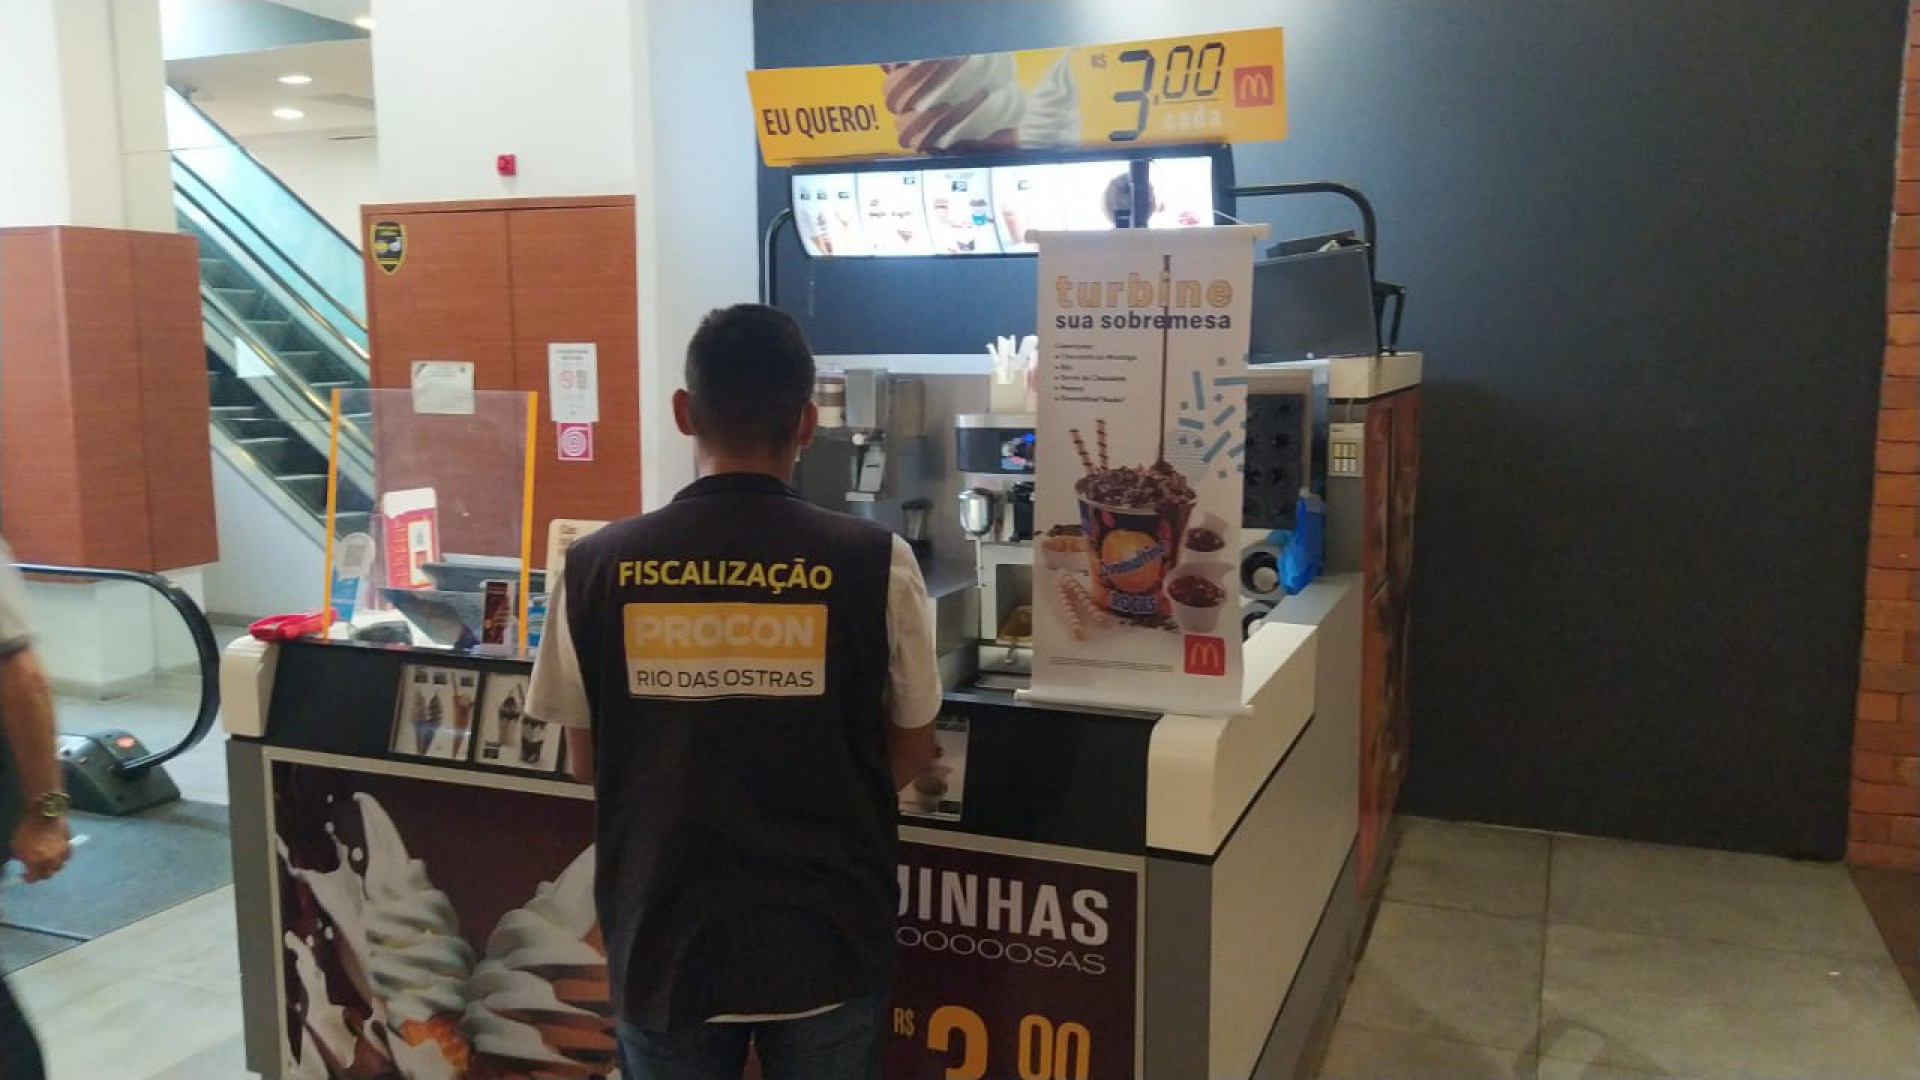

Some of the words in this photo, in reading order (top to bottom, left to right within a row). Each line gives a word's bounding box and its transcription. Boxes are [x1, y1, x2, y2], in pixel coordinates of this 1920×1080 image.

[762, 108, 791, 135] EU
[795, 104, 879, 138] QUERO!
[1163, 105, 1222, 131] cada
[1056, 271, 1233, 309] turbine
[1056, 313, 1093, 329] sua
[1101, 311, 1231, 329] sobremesa
[618, 558, 833, 594] FISCALIZAÇÃO
[634, 614, 815, 648] PROCON
[637, 669, 673, 687] RIO
[678, 671, 719, 687] DAS
[724, 669, 814, 687] OSTRAS
